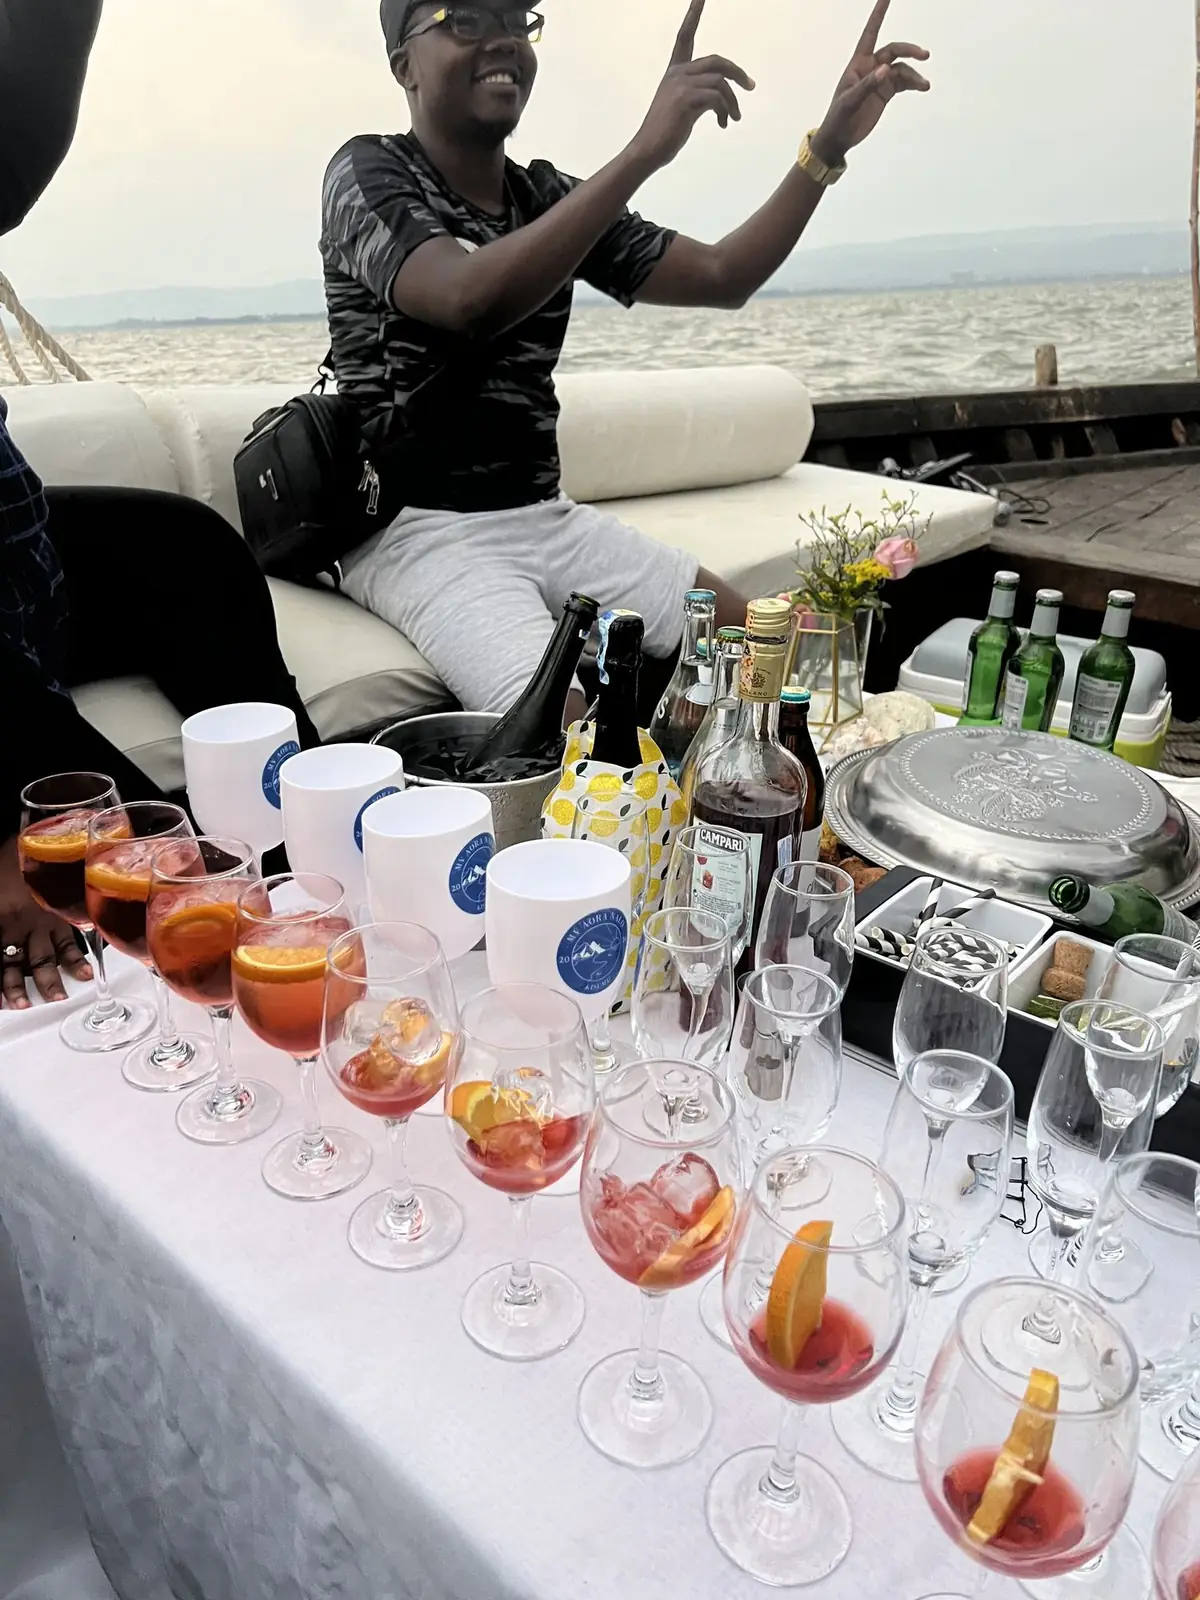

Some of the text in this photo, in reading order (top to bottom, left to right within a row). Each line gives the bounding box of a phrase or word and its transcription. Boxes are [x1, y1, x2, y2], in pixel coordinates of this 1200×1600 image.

[700, 829, 743, 852] CAMPARI
[451, 883, 461, 893] 20
[559, 955, 570, 964] 20
